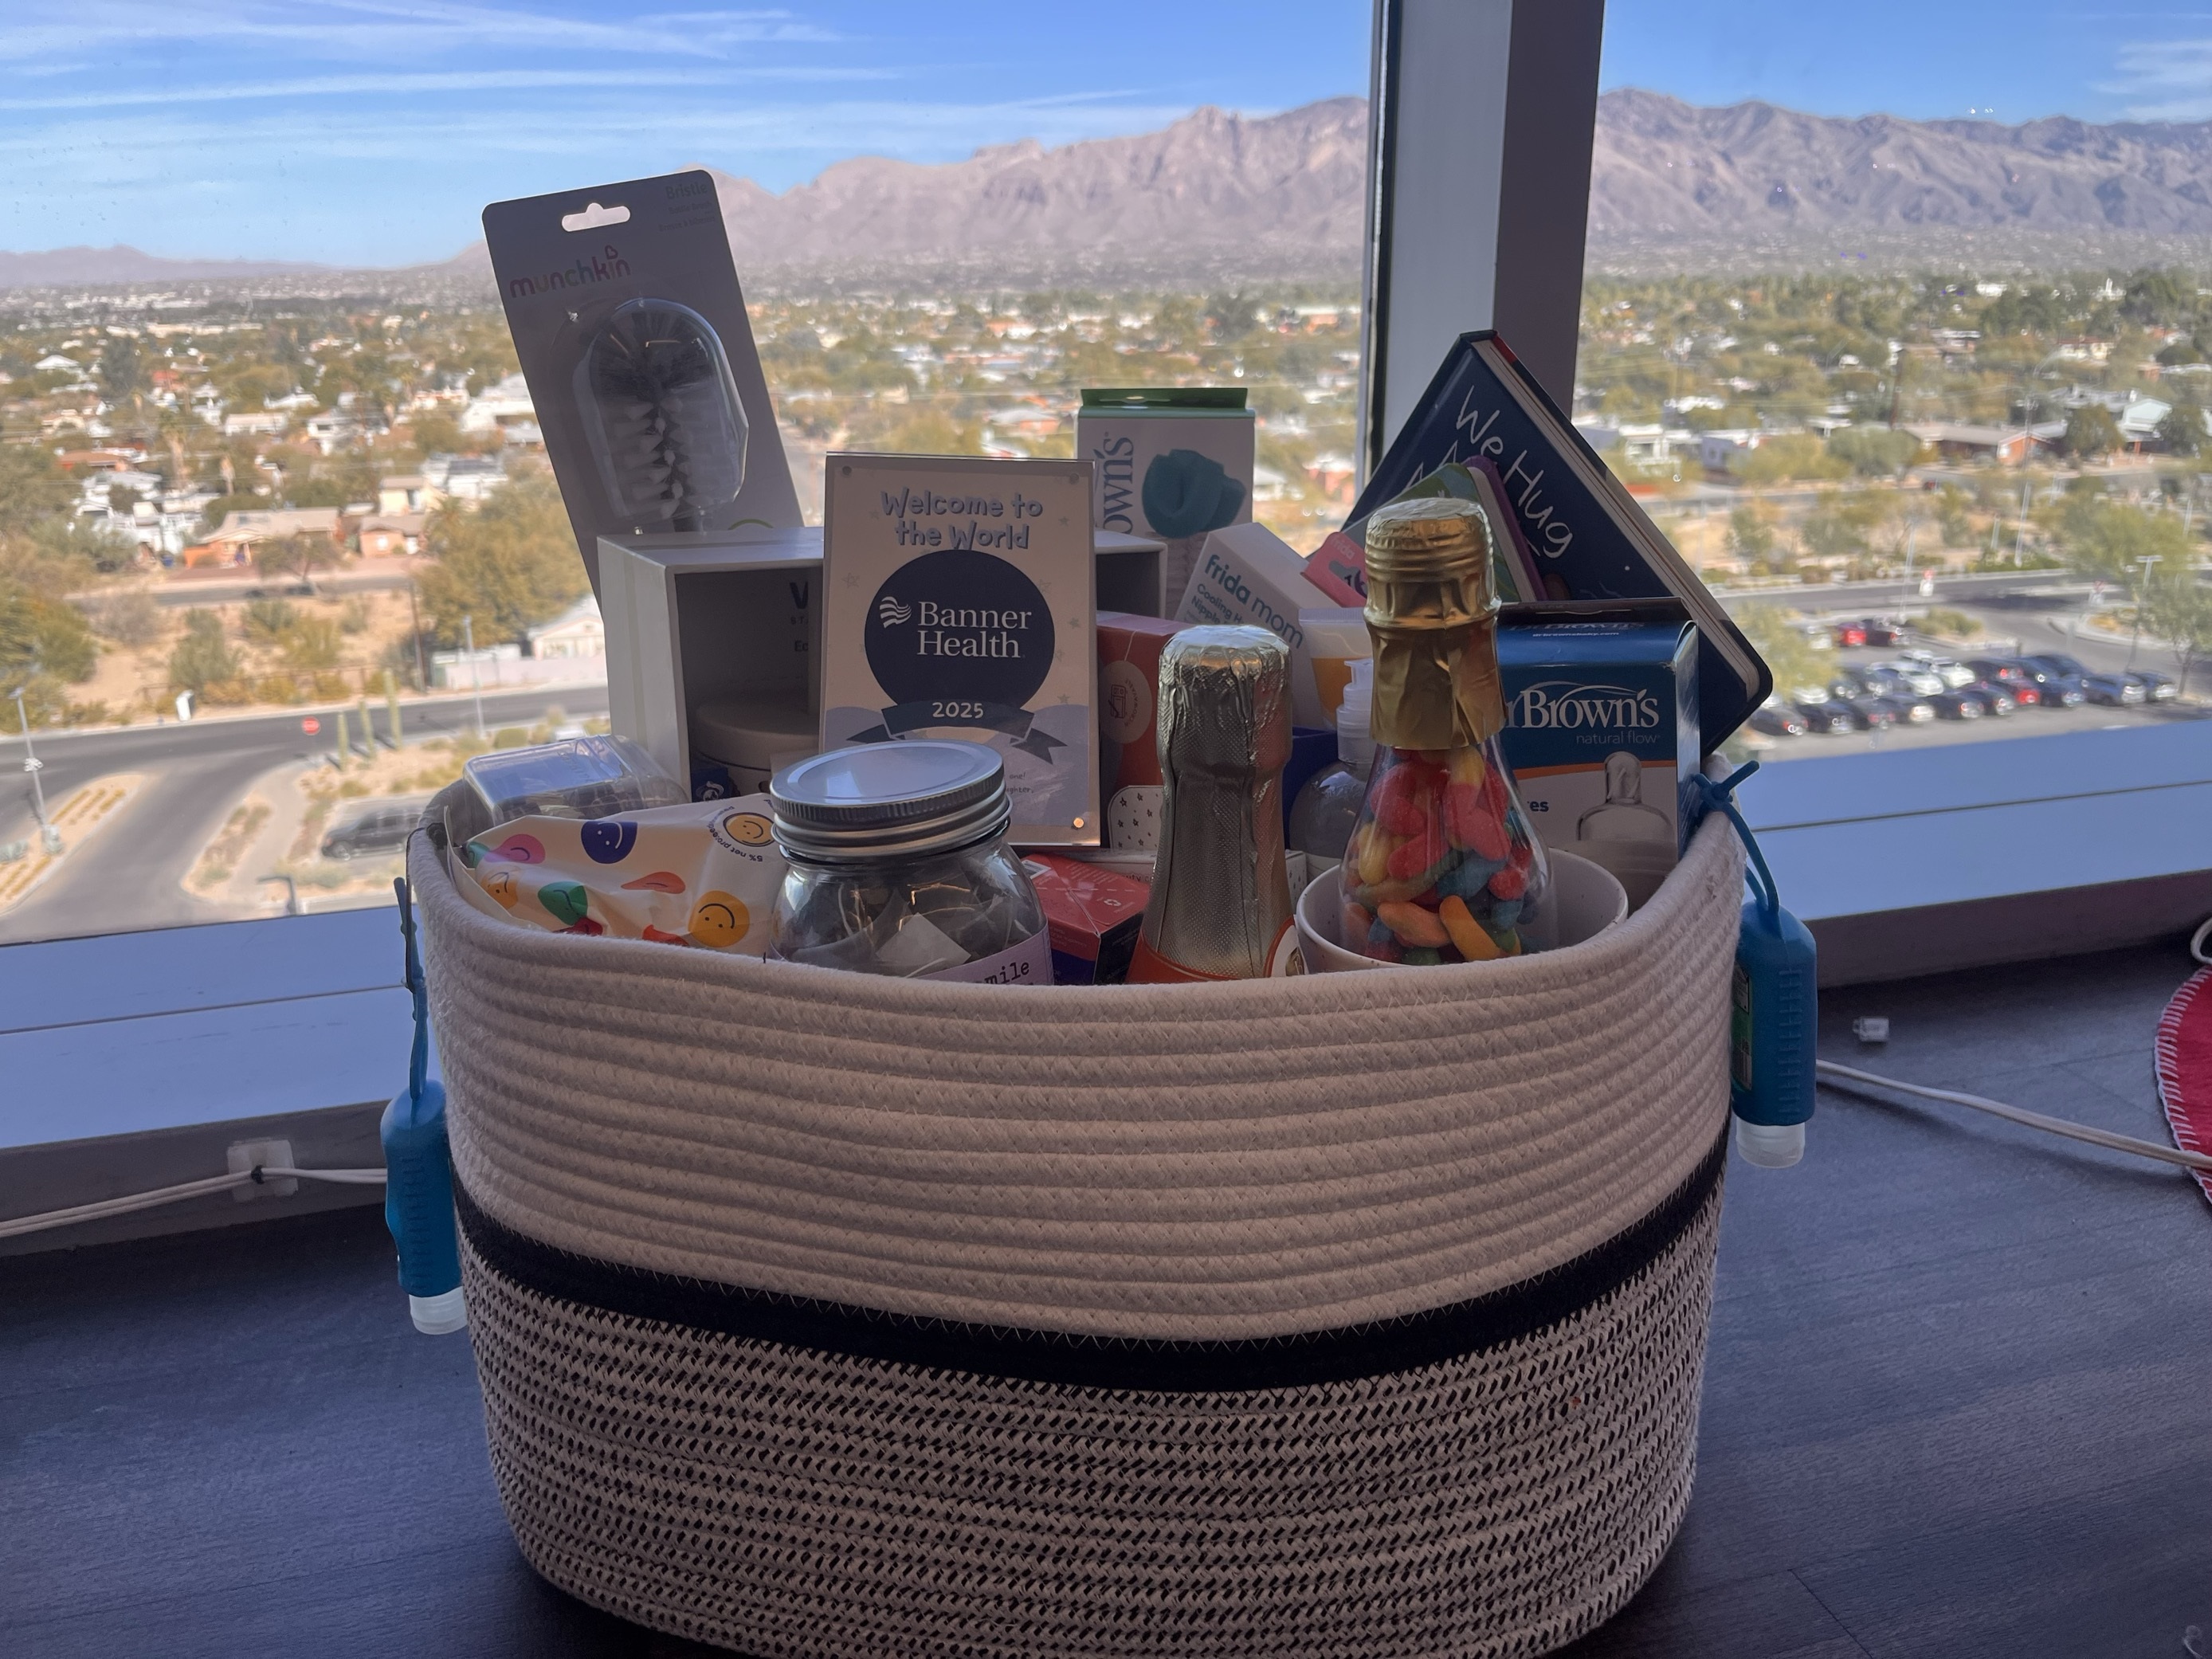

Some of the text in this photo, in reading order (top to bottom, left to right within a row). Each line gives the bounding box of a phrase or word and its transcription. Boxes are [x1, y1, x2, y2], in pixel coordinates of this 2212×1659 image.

[665, 181, 708, 199] Bristle
[509, 245, 631, 298] munchkin
[1093, 437, 1134, 535] own's
[1456, 385, 1504, 457] We
[1503, 449, 1574, 559] Hug
[880, 487, 1043, 518] Welcome to
[895, 520, 1030, 551] the World
[917, 601, 1032, 629] Banner
[1197, 583, 1233, 620] Cooling
[1250, 597, 1304, 649] mom
[916, 630, 1022, 659] Health
[931, 701, 984, 719] 2025
[1520, 688, 1660, 729] Brown's
[1576, 730, 1657, 745] natural flow
[1005, 786, 1034, 795] ughter,
[1527, 801, 1549, 813] es
[730, 847, 747, 858] net
[749, 853, 763, 862] 5%
[975, 961, 1030, 985] mile
